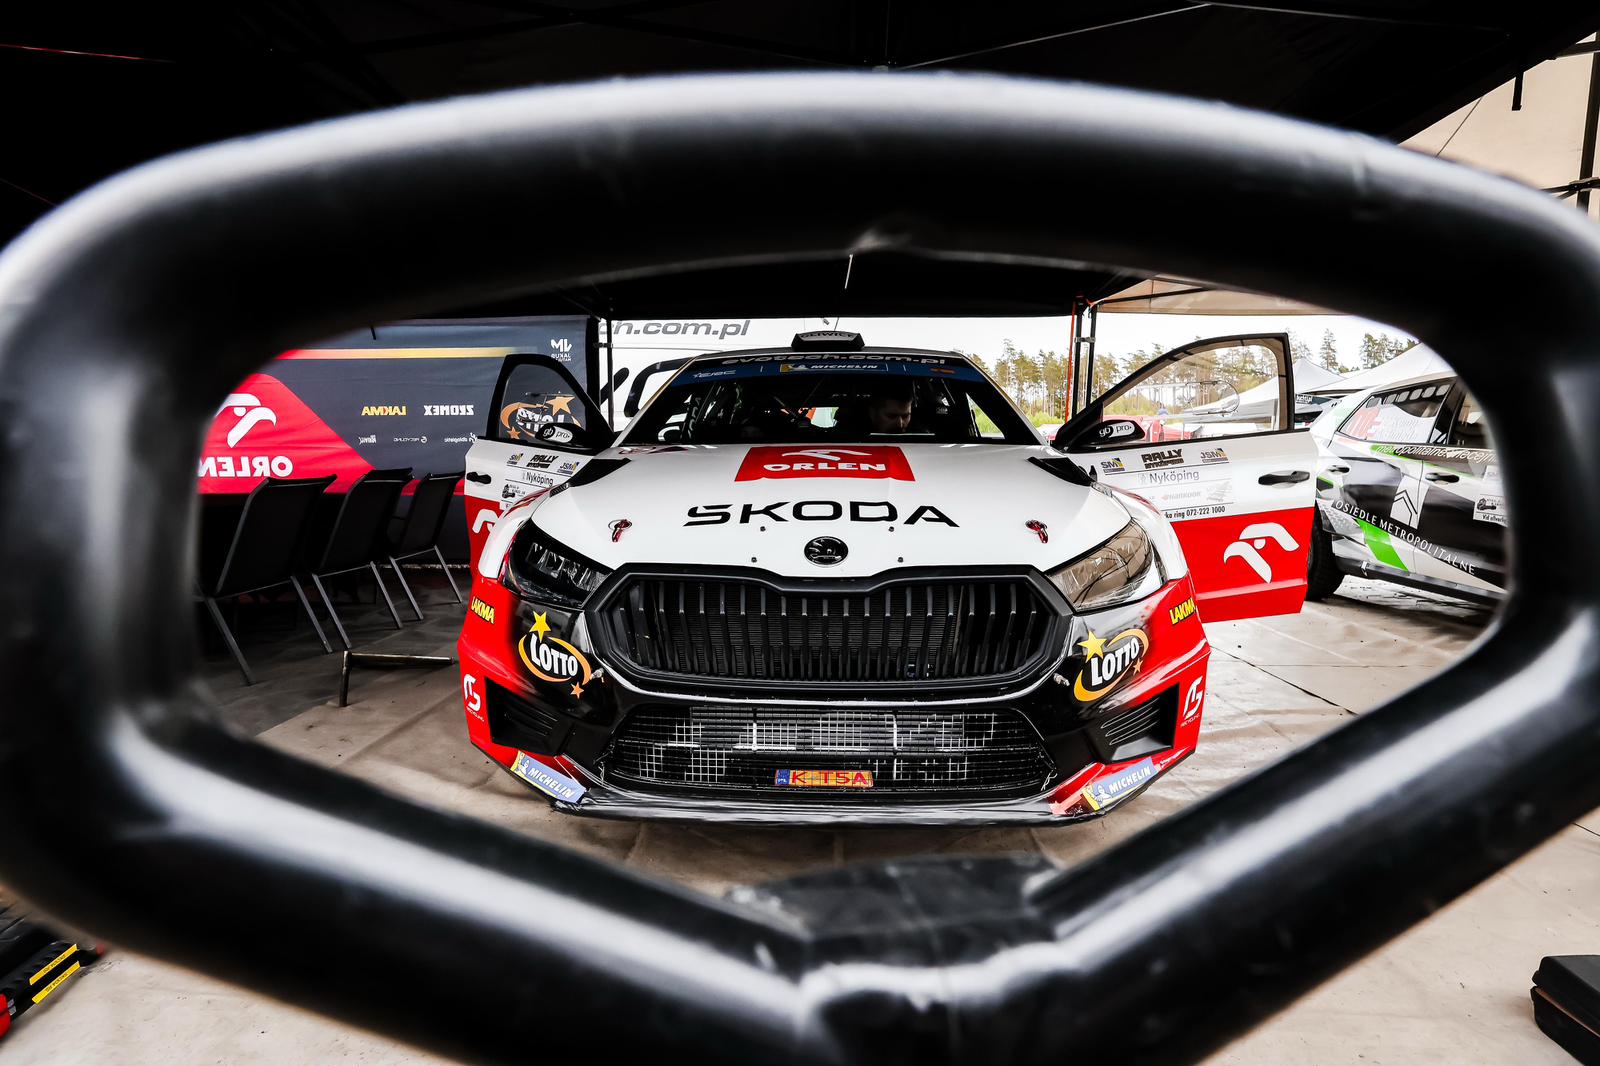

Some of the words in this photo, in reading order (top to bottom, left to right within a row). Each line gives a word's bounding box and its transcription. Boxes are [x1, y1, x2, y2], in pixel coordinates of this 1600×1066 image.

[530, 454, 559, 463] RALLY
[1141, 448, 1183, 463] RALLY
[763, 462, 886, 471] ORLEN
[526, 471, 554, 487] Nyköping
[1149, 471, 1200, 484] Nyköping
[1186, 507, 1210, 516] 072-222
[1211, 505, 1226, 513] 1000
[1335, 500, 1377, 526] OSIEDLE
[1379, 519, 1476, 576] METROPOLITALNE
[471, 596, 495, 624] LAKMA
[530, 633, 579, 677] LOTTO
[1091, 638, 1140, 686] LOTTO
[528, 768, 575, 798] MICHELIN
[1109, 767, 1151, 794] MICHELIN
